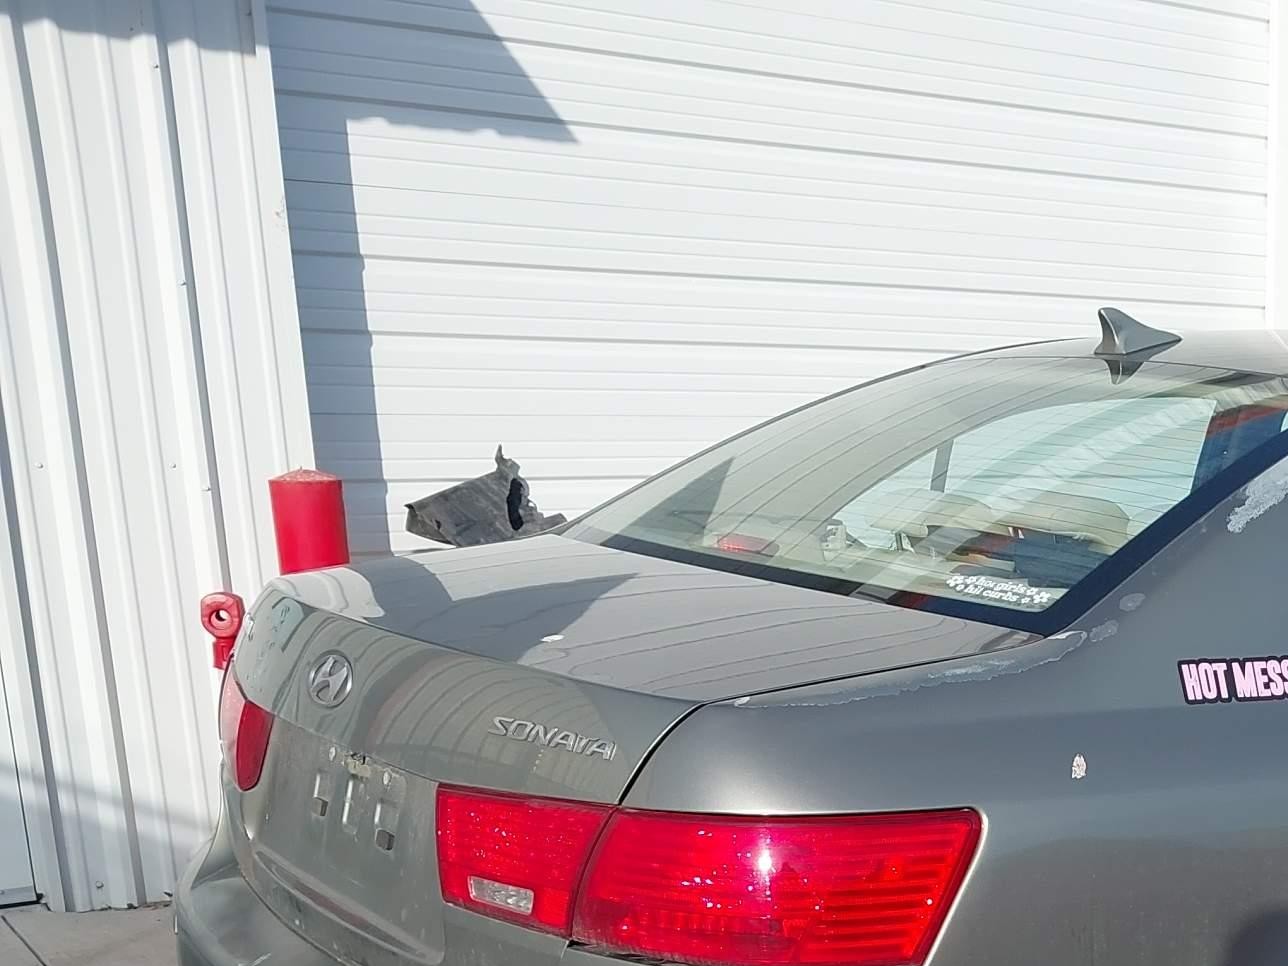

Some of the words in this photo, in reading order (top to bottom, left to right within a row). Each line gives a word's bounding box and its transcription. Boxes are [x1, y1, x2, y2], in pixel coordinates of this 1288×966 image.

[983, 589, 1019, 602] curbs
[994, 582, 1027, 594] girls
[1181, 662, 1229, 701] HOT
[488, 716, 618, 761] SONATA
